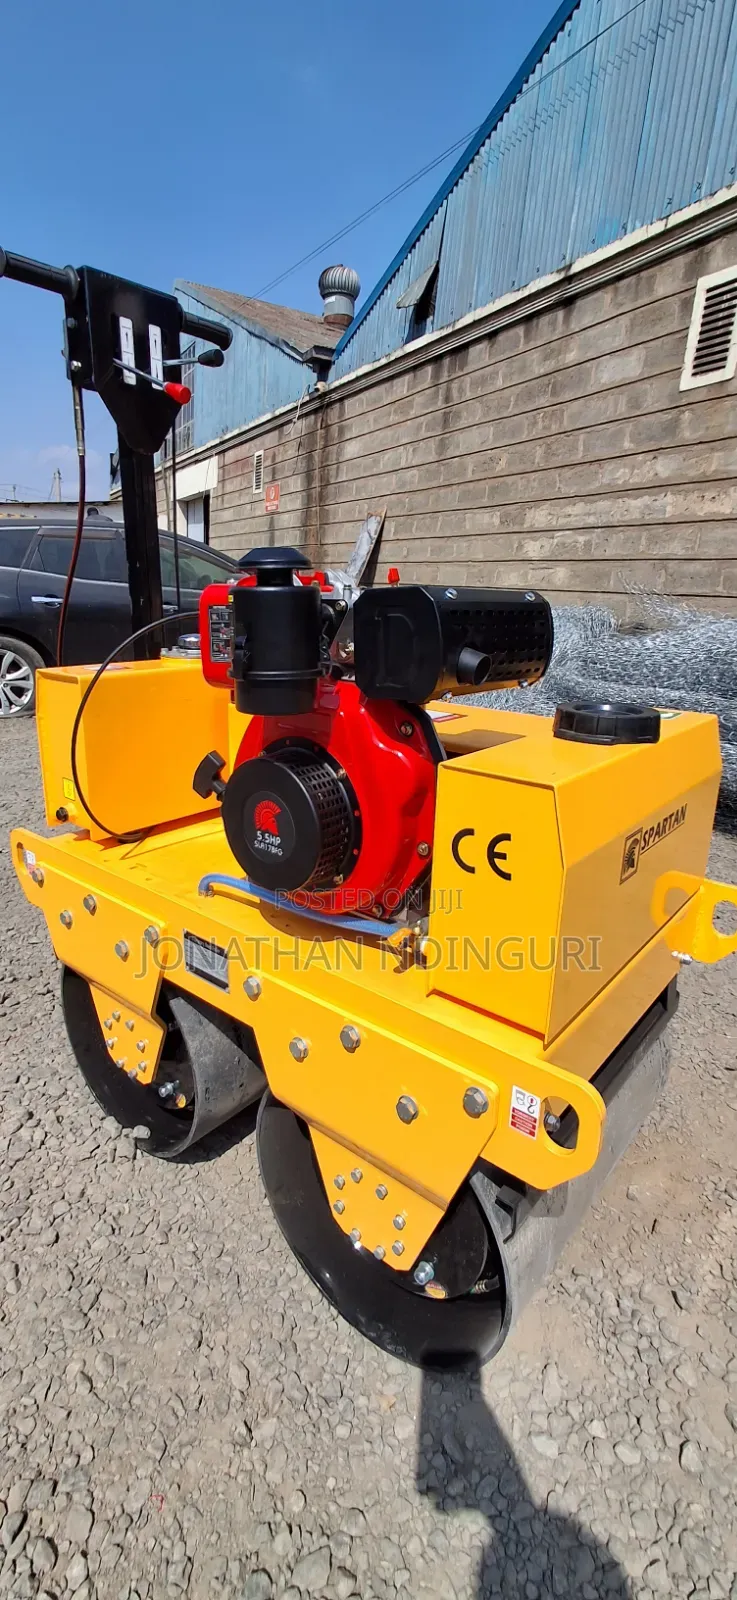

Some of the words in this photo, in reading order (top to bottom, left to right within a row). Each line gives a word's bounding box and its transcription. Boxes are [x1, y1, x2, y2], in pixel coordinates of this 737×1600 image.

[256, 830, 281, 846] 5.5HP
[641, 802, 688, 851] SPARTAN
[451, 827, 512, 881] CE
